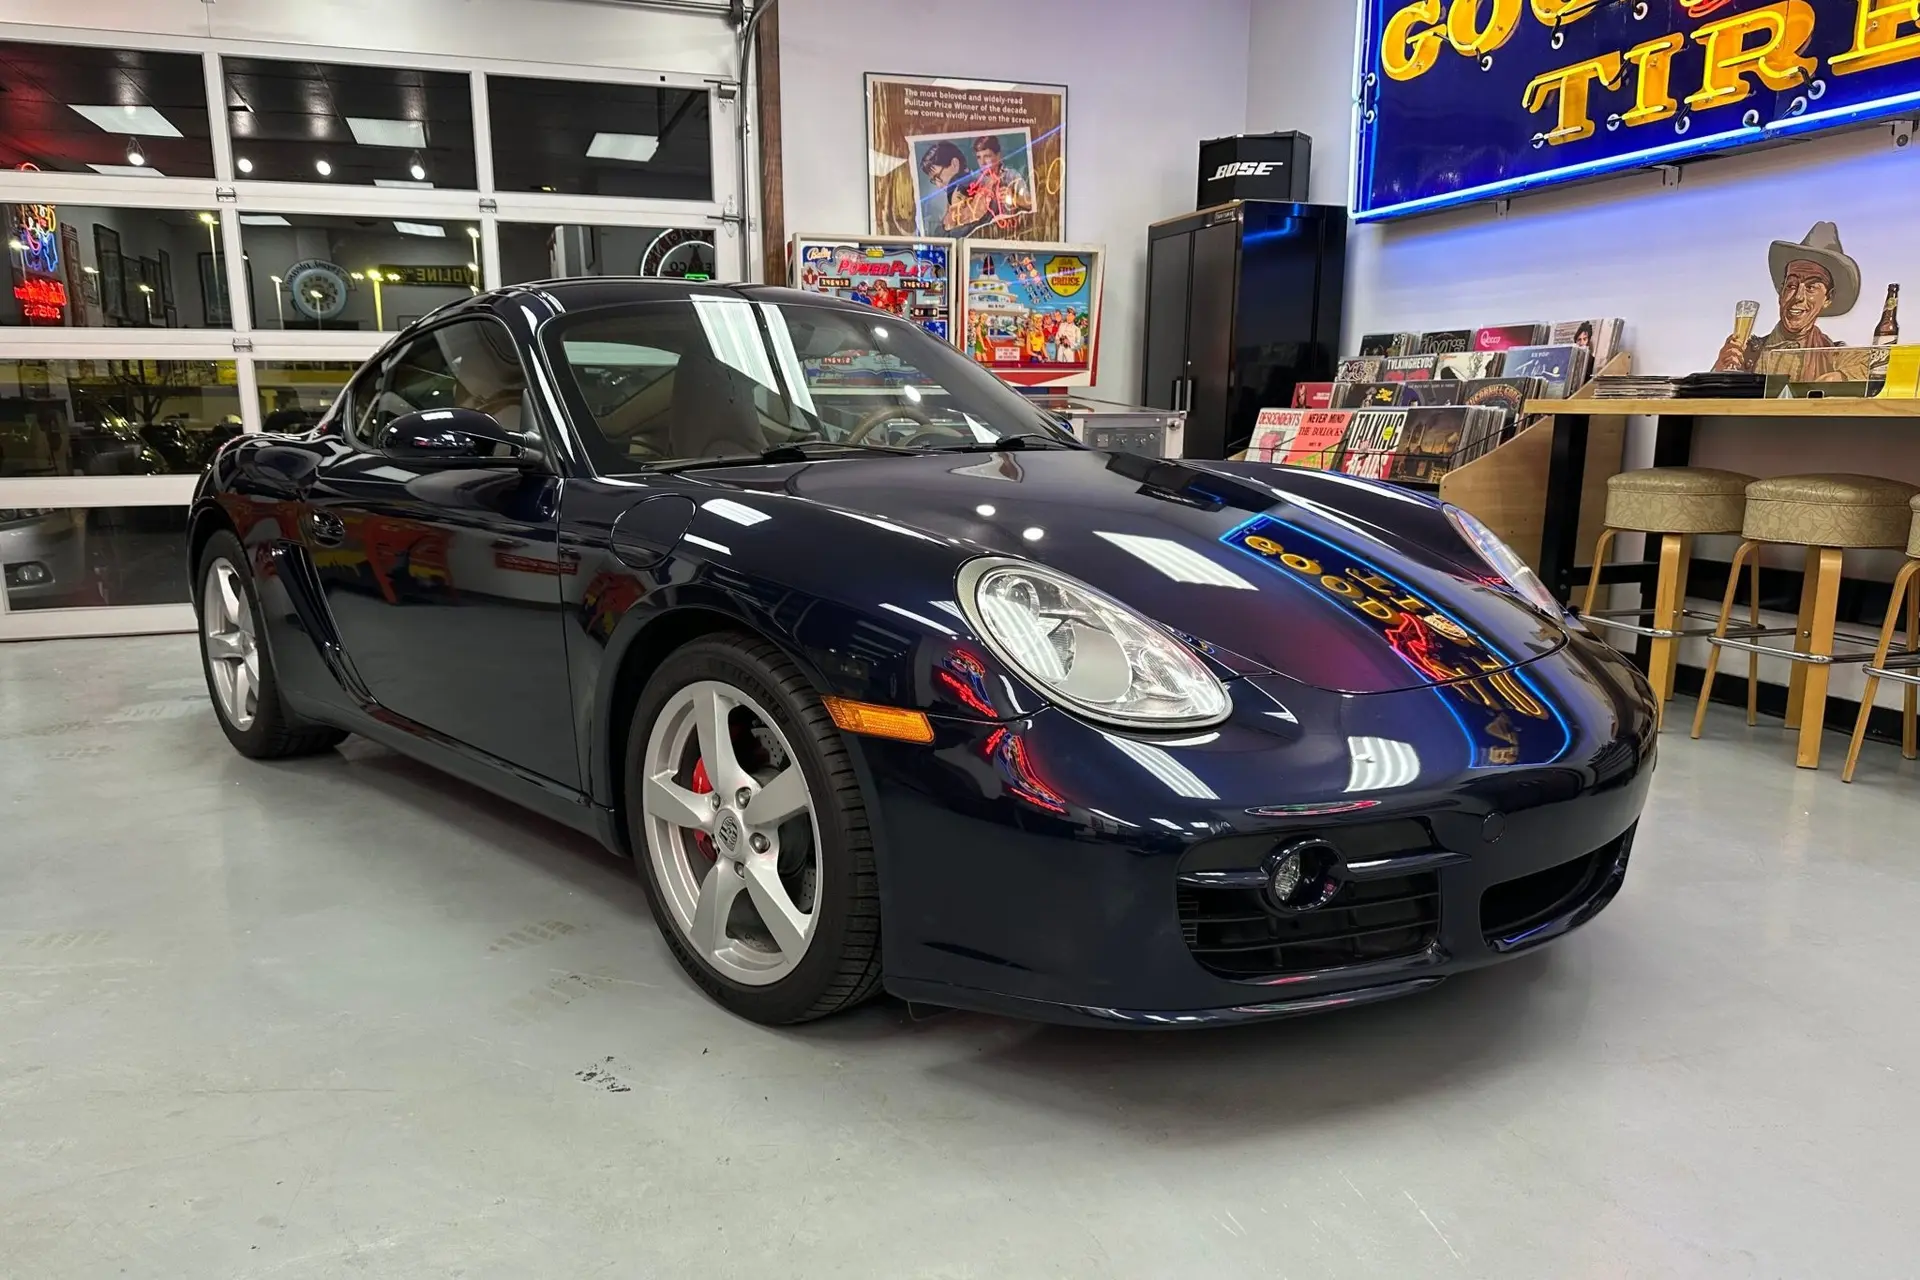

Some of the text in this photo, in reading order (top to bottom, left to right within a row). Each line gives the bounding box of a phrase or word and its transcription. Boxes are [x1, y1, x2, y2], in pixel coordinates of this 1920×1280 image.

[904, 87, 1023, 105] The most beloved and widely-read
[904, 97, 1028, 115] Pulitzer Prize Winner of the decade
[920, 110, 944, 118] comes
[945, 111, 968, 121] vividly
[969, 113, 987, 121] alive
[998, 114, 1010, 123] the
[1207, 162, 1283, 181] BOSE
[807, 247, 832, 260] Bally
[1258, 412, 1301, 426] DESCENDENTS
[1307, 413, 1345, 424] NEVER MIND
[1299, 427, 1344, 437] THE BOLLOCKS
[1349, 412, 1405, 449] TALKING
